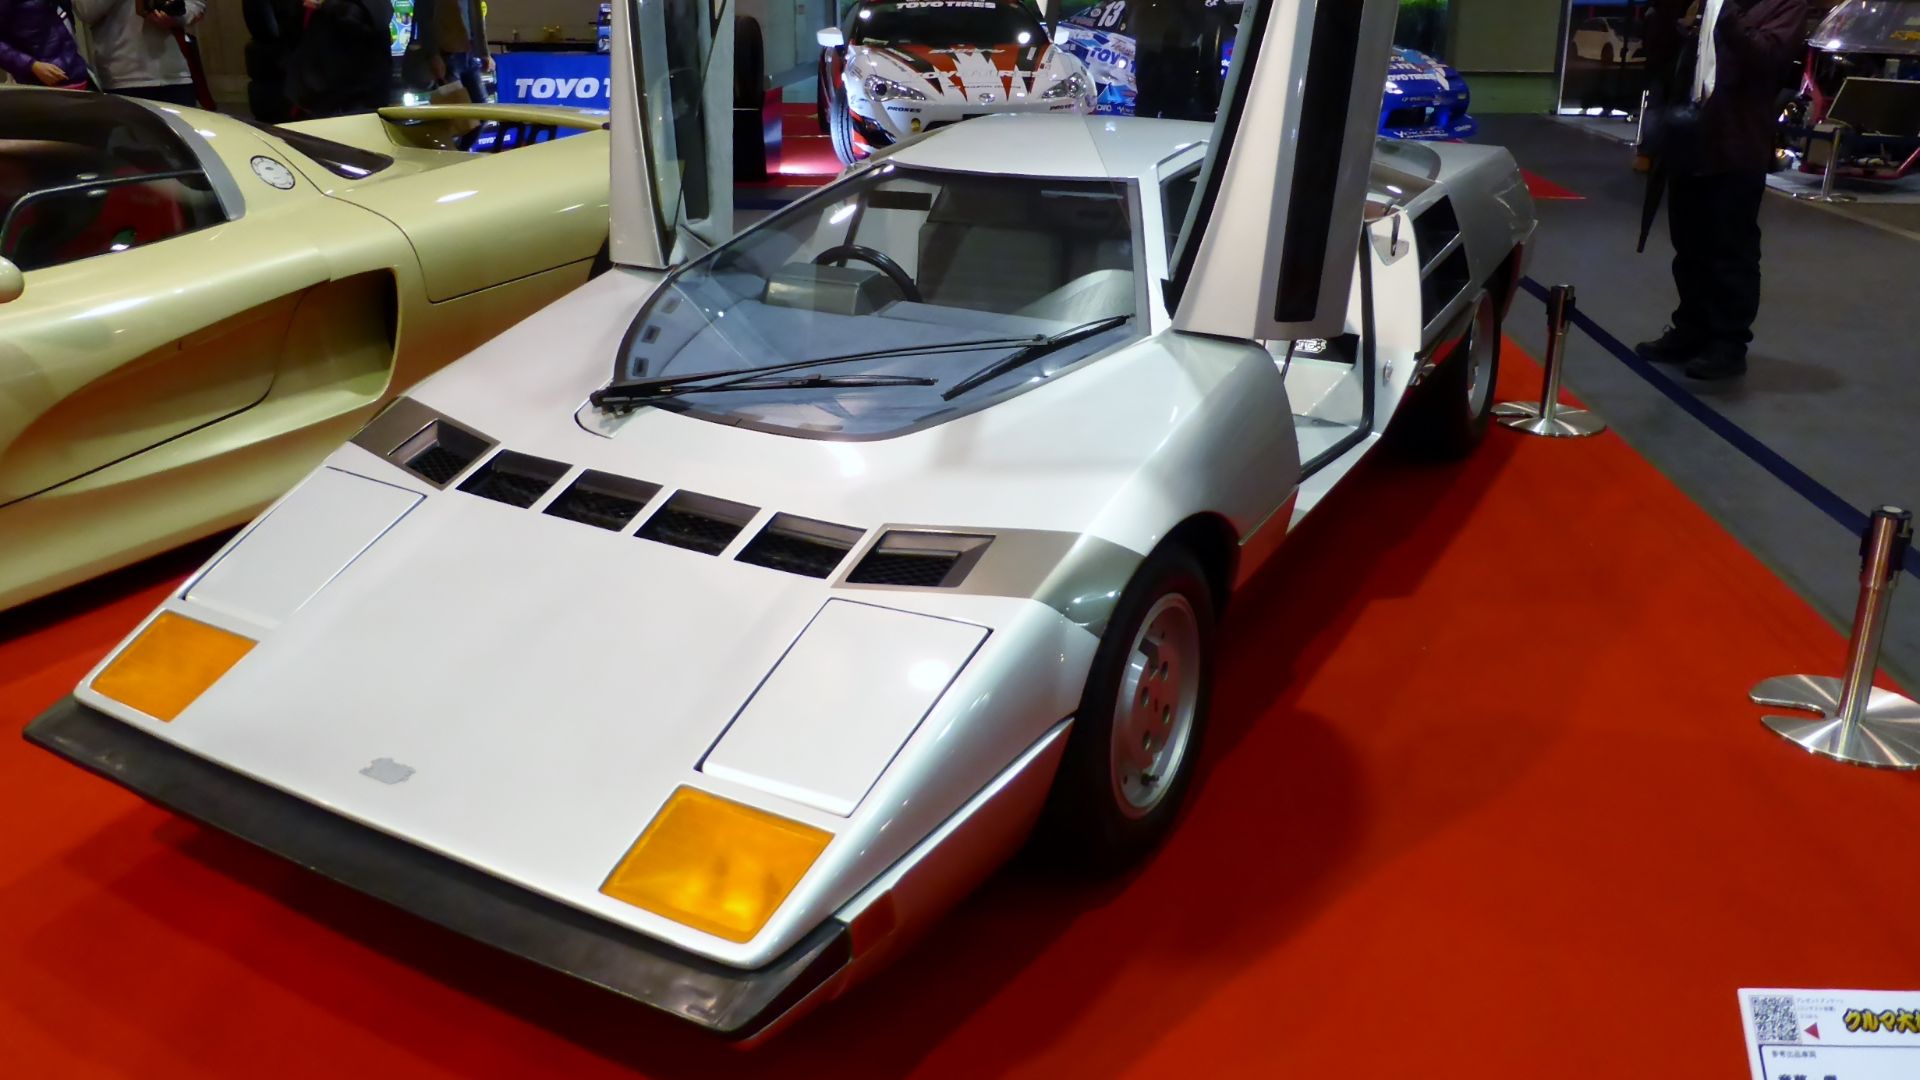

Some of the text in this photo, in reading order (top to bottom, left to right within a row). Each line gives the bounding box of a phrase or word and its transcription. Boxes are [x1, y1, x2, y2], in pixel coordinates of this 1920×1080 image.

[897, 1, 996, 9] TOYO TIRES
[1097, 0, 1126, 27] 13
[1090, 47, 1129, 70] TOYO
[515, 77, 600, 99] TOYO
